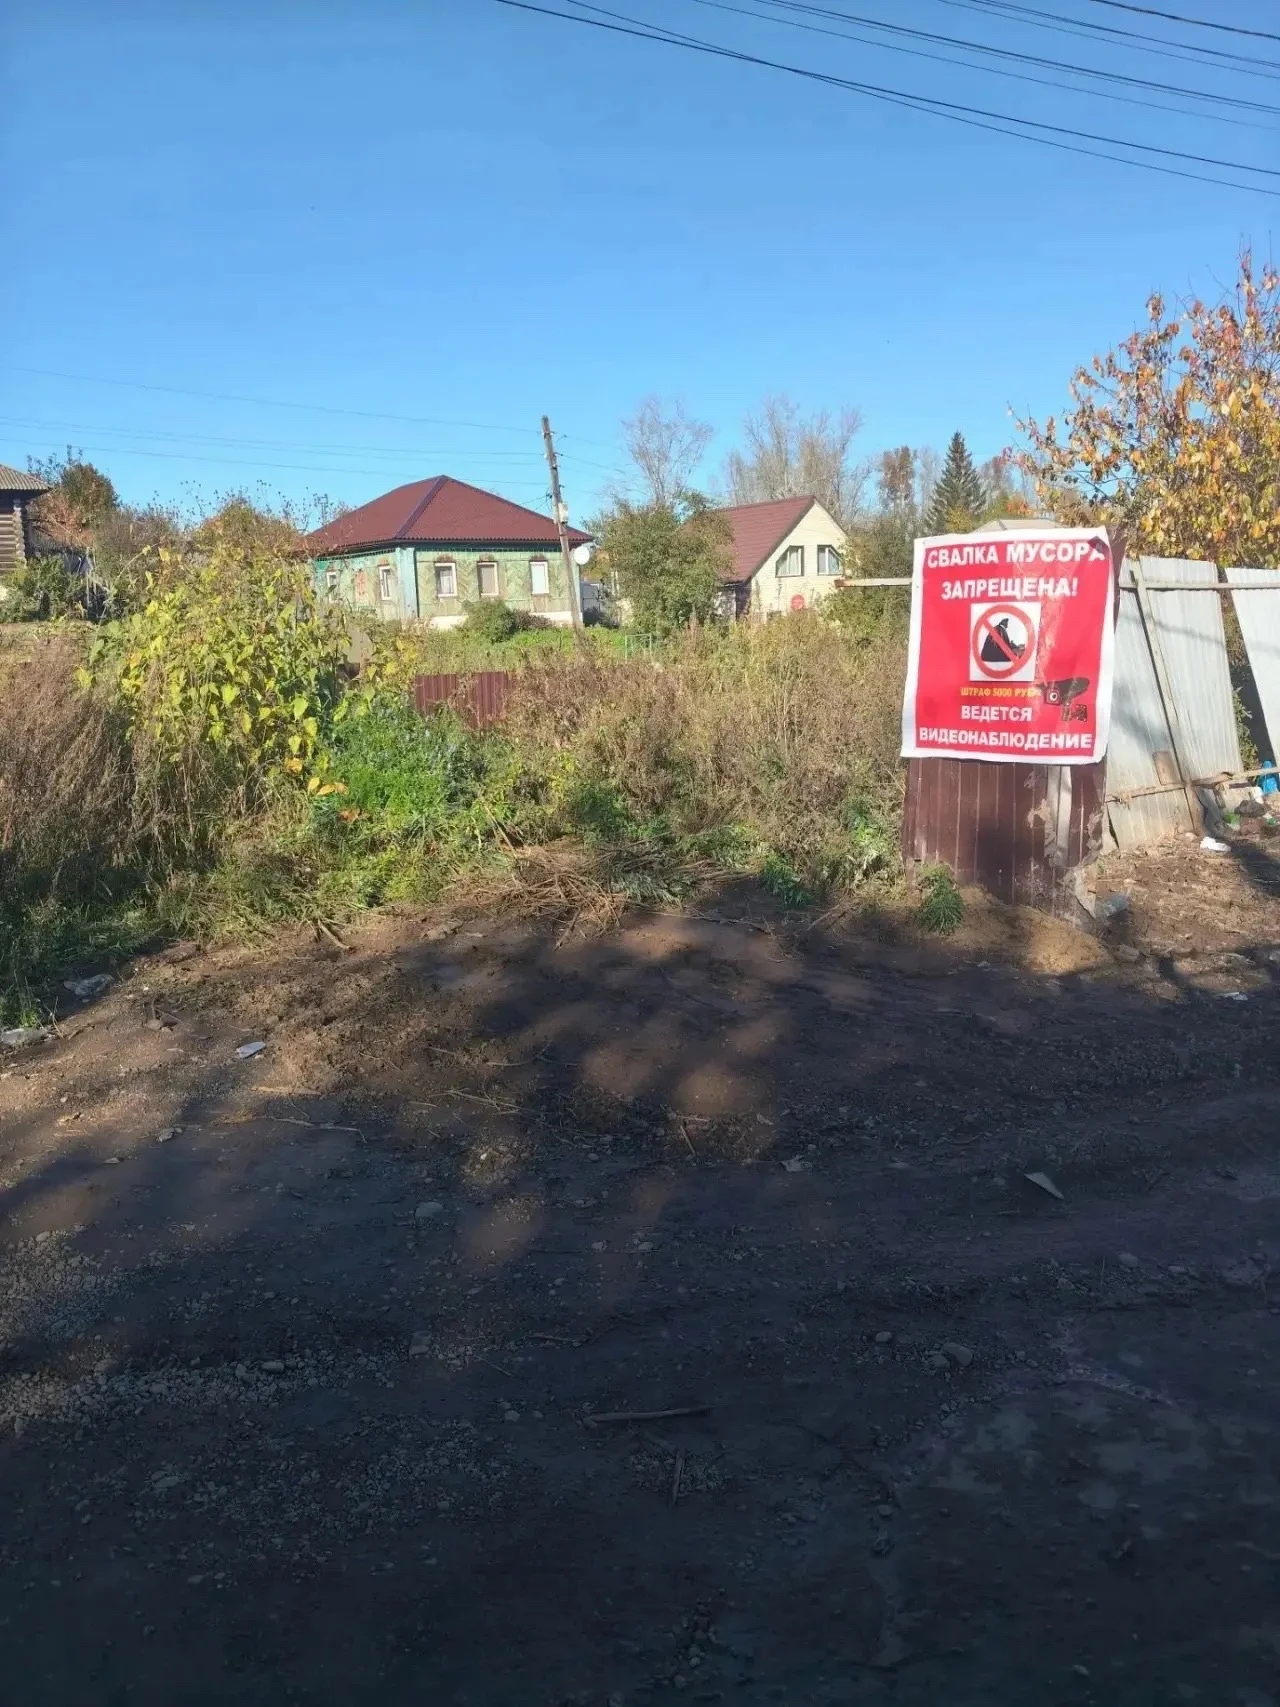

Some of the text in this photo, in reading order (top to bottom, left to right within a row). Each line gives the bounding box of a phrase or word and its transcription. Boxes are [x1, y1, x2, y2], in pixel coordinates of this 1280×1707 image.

[928, 543, 1105, 568] СВАЛКА МУСОРА
[942, 578, 1078, 600] ЗАПРЕЩЕНА!
[960, 687, 991, 697] ШТРАФ
[993, 687, 1012, 698] 5000
[961, 706, 1032, 722] ВЕДЕТСЯ
[919, 727, 1093, 750] ВИДЕОНАБЛЮДЕНИЕ
